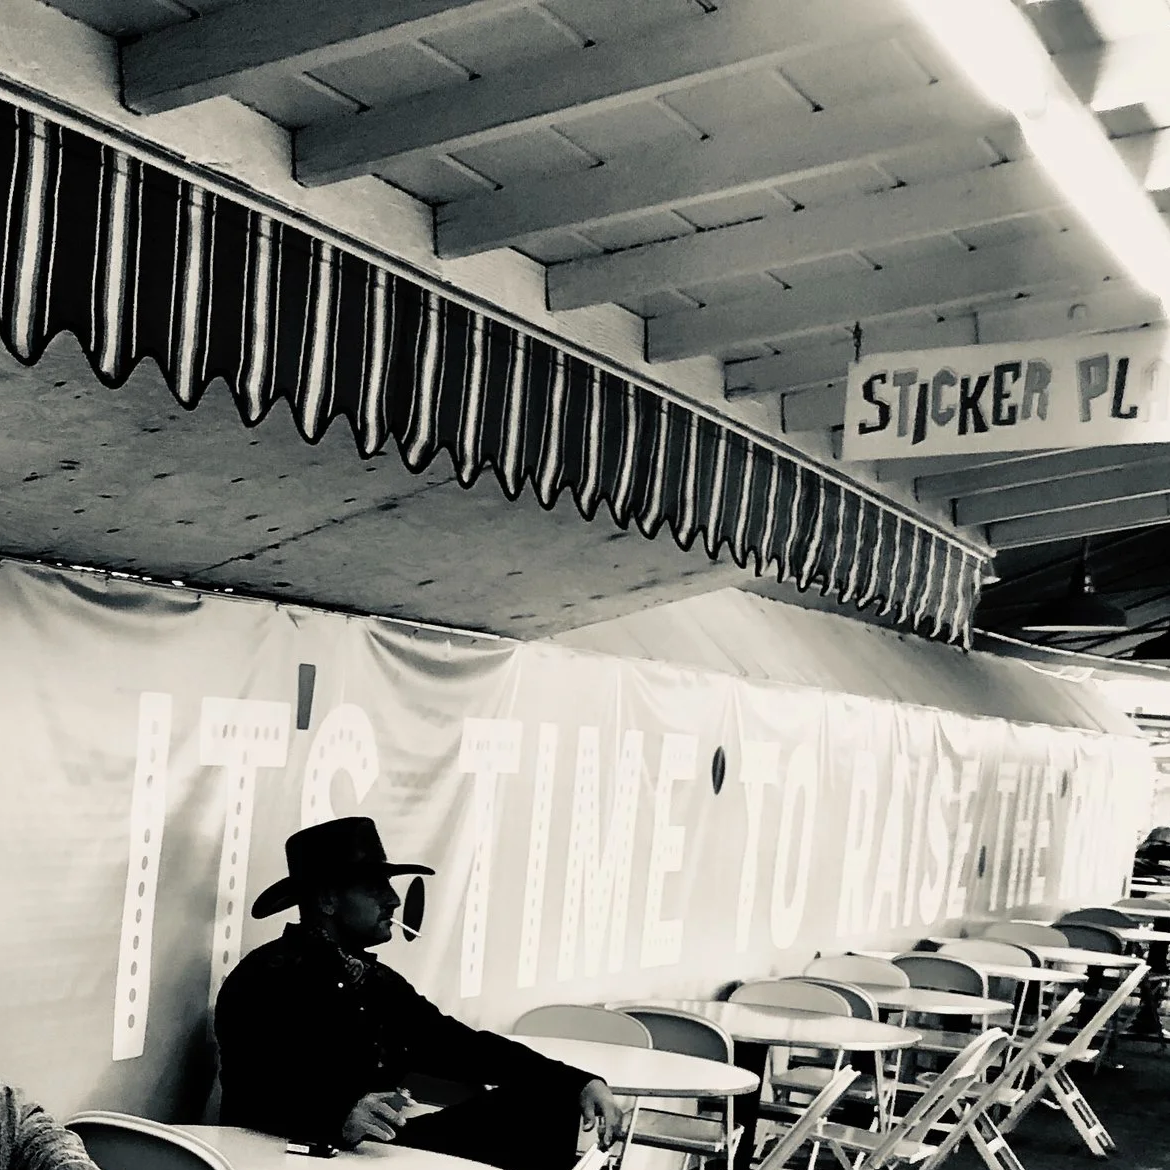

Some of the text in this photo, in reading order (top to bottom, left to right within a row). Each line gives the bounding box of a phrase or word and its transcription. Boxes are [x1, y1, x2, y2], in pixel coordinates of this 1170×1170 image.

[857, 358, 1053, 446] STICKER
[459, 717, 699, 999] TIME
[735, 740, 819, 953] TO
[835, 748, 981, 938] RAISE
[988, 760, 1056, 912] THE
